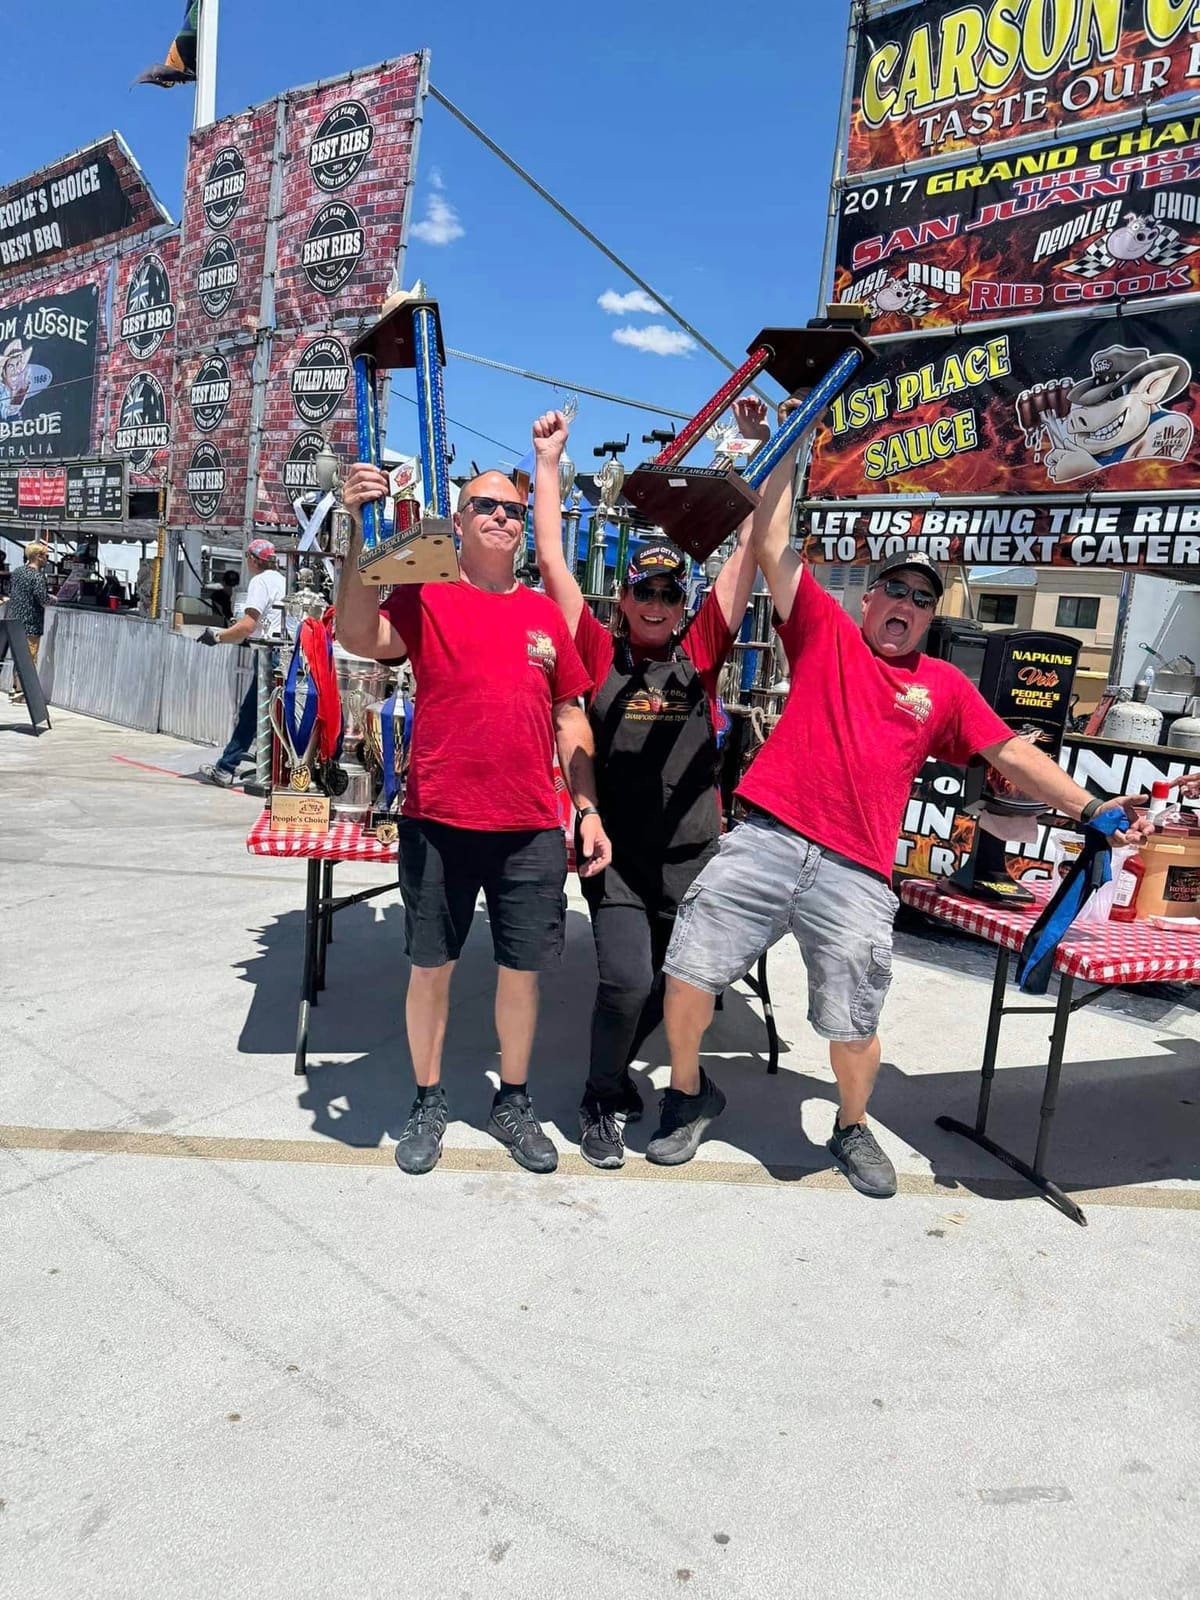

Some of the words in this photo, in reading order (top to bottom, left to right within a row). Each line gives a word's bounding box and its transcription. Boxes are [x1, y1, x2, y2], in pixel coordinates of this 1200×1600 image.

[861, 0, 1123, 129] CARSON
[919, 87, 1048, 148] TASTE
[1062, 56, 1172, 112] OUR
[310, 137, 339, 165] BEST
[339, 128, 370, 156] RIBS
[50, 163, 101, 209] CHOICE
[203, 180, 223, 204] BEST
[223, 173, 245, 197] RIBS
[843, 179, 919, 215] 2017
[926, 146, 1077, 196] GRAND
[1012, 164, 1101, 195] THE
[852, 214, 959, 270] SAN
[965, 174, 1130, 232] JUAN
[1, 232, 32, 266] BEST
[33, 222, 62, 253] BBQ
[303, 237, 330, 264] BEST
[331, 231, 361, 257] RIBS
[199, 269, 217, 291] BEST
[217, 264, 238, 286] RIBS
[908, 262, 961, 295] RIBS
[969, 280, 1043, 311] RIB
[1053, 265, 1192, 303] COOK
[23, 306, 93, 345] AUSSIE
[122, 313, 146, 336] BEST
[147, 307, 172, 329] BBQ
[191, 384, 210, 404] BEST
[209, 382, 230, 402] RIBS
[292, 369, 323, 391] PULLED
[322, 368, 348, 390] PORK
[831, 379, 890, 435] 1ST
[896, 334, 1012, 412] PLACE
[116, 429, 137, 449] BEST
[137, 427, 168, 446] SAUCE
[863, 409, 977, 482] SAUCE
[188, 471, 205, 490] BEST
[205, 471, 224, 490] RIBS
[285, 463, 306, 485] BEST
[663, 466, 686, 474] PLACE
[811, 511, 861, 535] LET
[868, 510, 913, 534] US
[922, 509, 1036, 534] BRING
[1047, 507, 1121, 533] THE
[821, 536, 856, 561] TO
[868, 536, 951, 561] YOUR
[963, 536, 1063, 562] NEXT
[1012, 650, 1073, 665] NAPKINS
[1011, 688, 1060, 701] PEOPLE'S
[1015, 697, 1054, 708] CHOICE
[272, 815, 303, 824] People's
[304, 816, 328, 824] Choice
